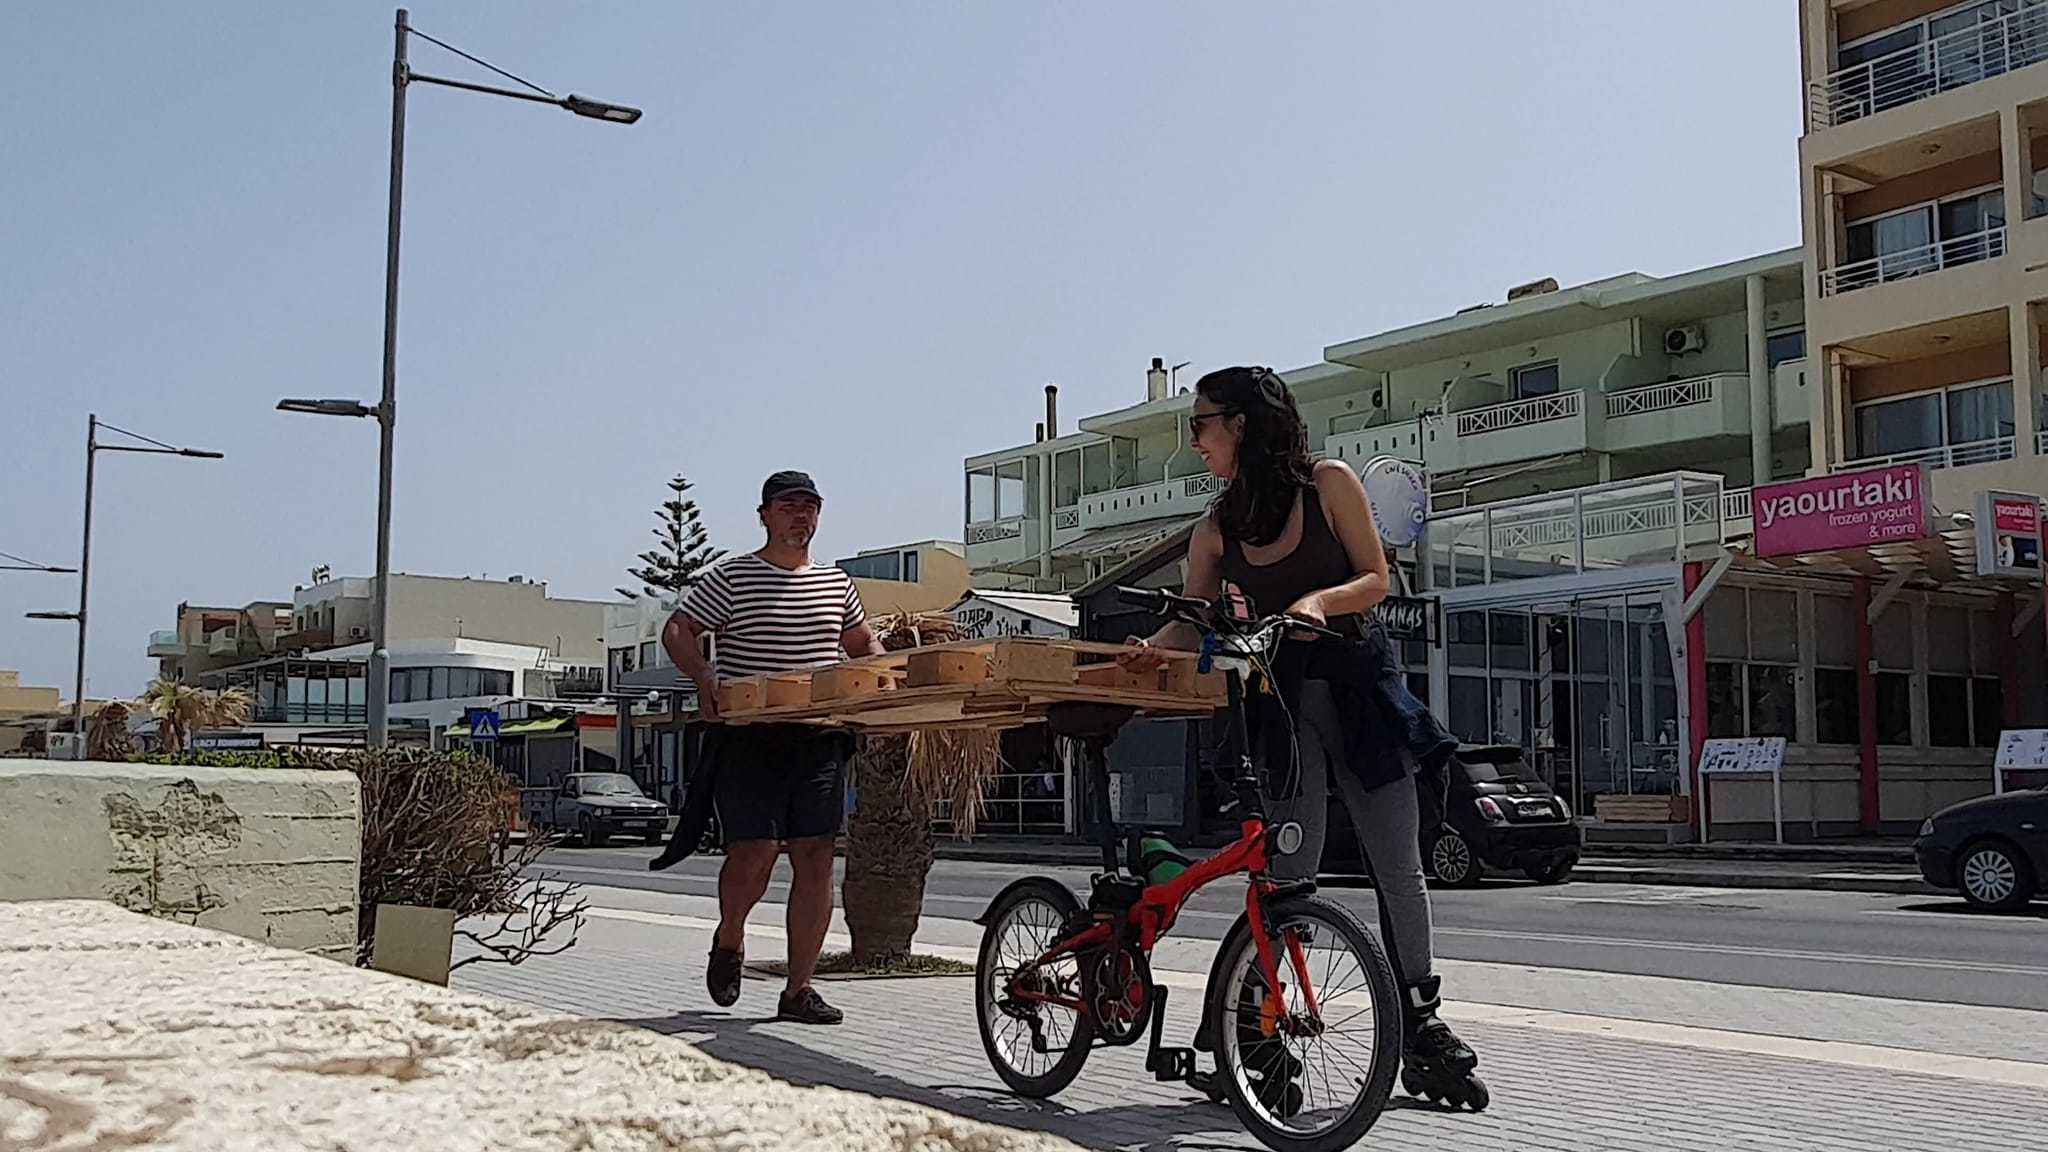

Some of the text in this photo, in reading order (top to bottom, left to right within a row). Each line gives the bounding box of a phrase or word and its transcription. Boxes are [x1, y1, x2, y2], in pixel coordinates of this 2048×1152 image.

[1760, 471, 1914, 528] yaourtaki
[1829, 504, 1913, 526] frozen yogurt
[1869, 523, 1916, 538] & more
[1375, 603, 1423, 630] NANAS
